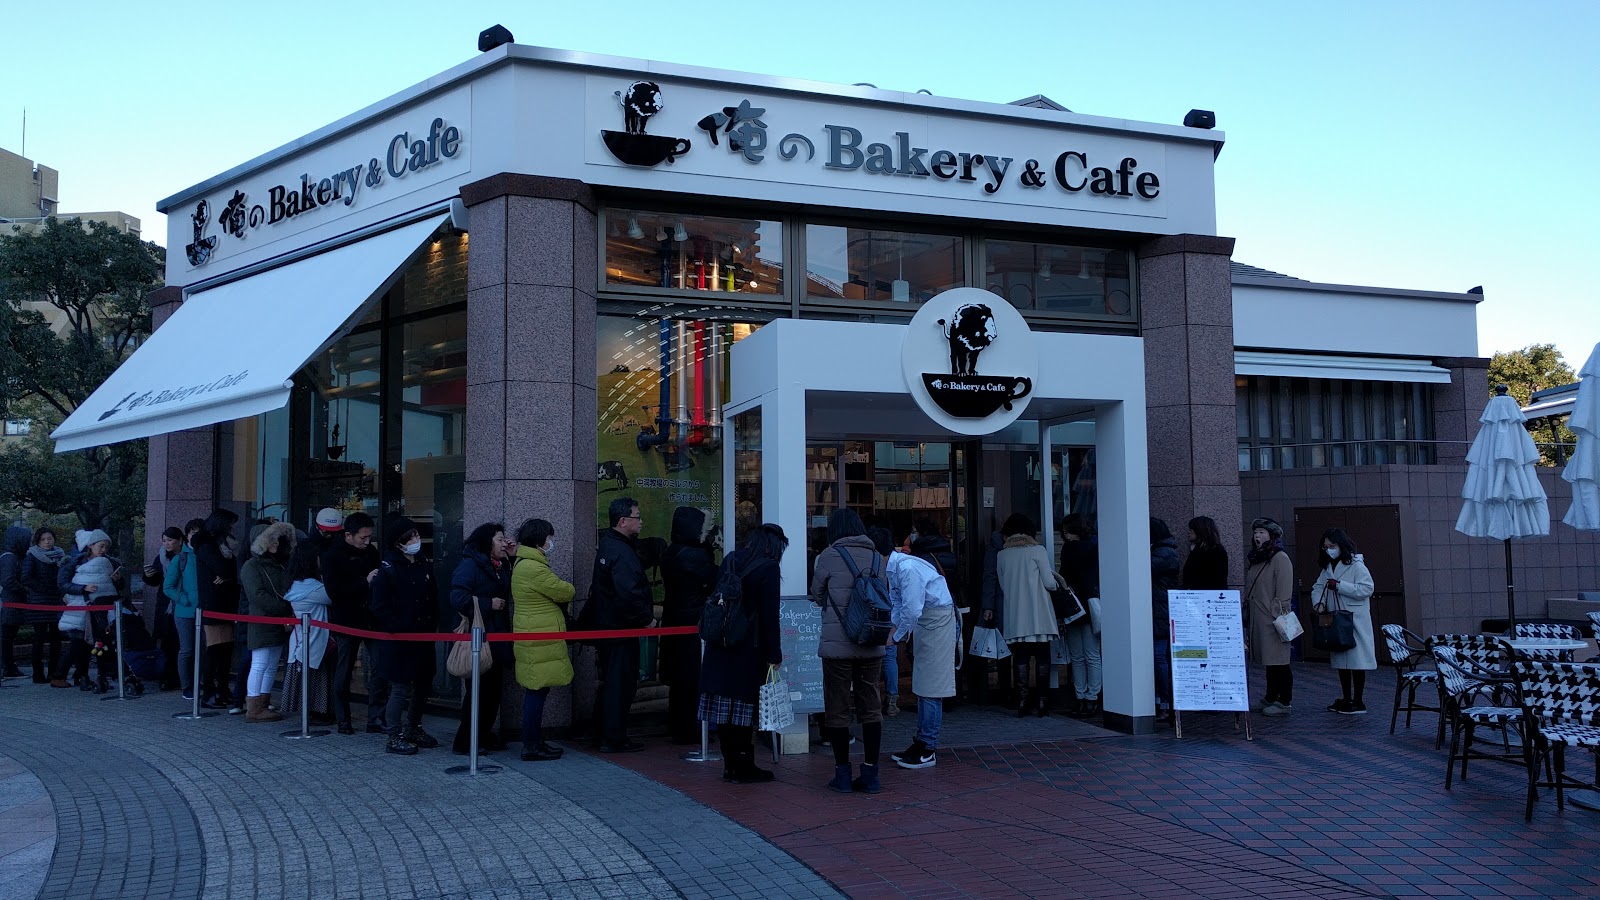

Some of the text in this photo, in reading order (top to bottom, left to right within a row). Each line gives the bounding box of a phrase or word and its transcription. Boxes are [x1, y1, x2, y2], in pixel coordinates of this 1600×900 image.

[267, 164, 363, 226] Bakery
[365, 157, 382, 188] &
[386, 117, 459, 178] Cafe
[824, 124, 1014, 194] Bakery
[1020, 158, 1046, 188] &
[1055, 151, 1160, 200] Cafe
[147, 384, 203, 407] Bakery
[207, 369, 249, 393] Cafe
[949, 381, 980, 392] Bakery
[986, 383, 1006, 392] Cafe
[791, 619, 798, 627] &
